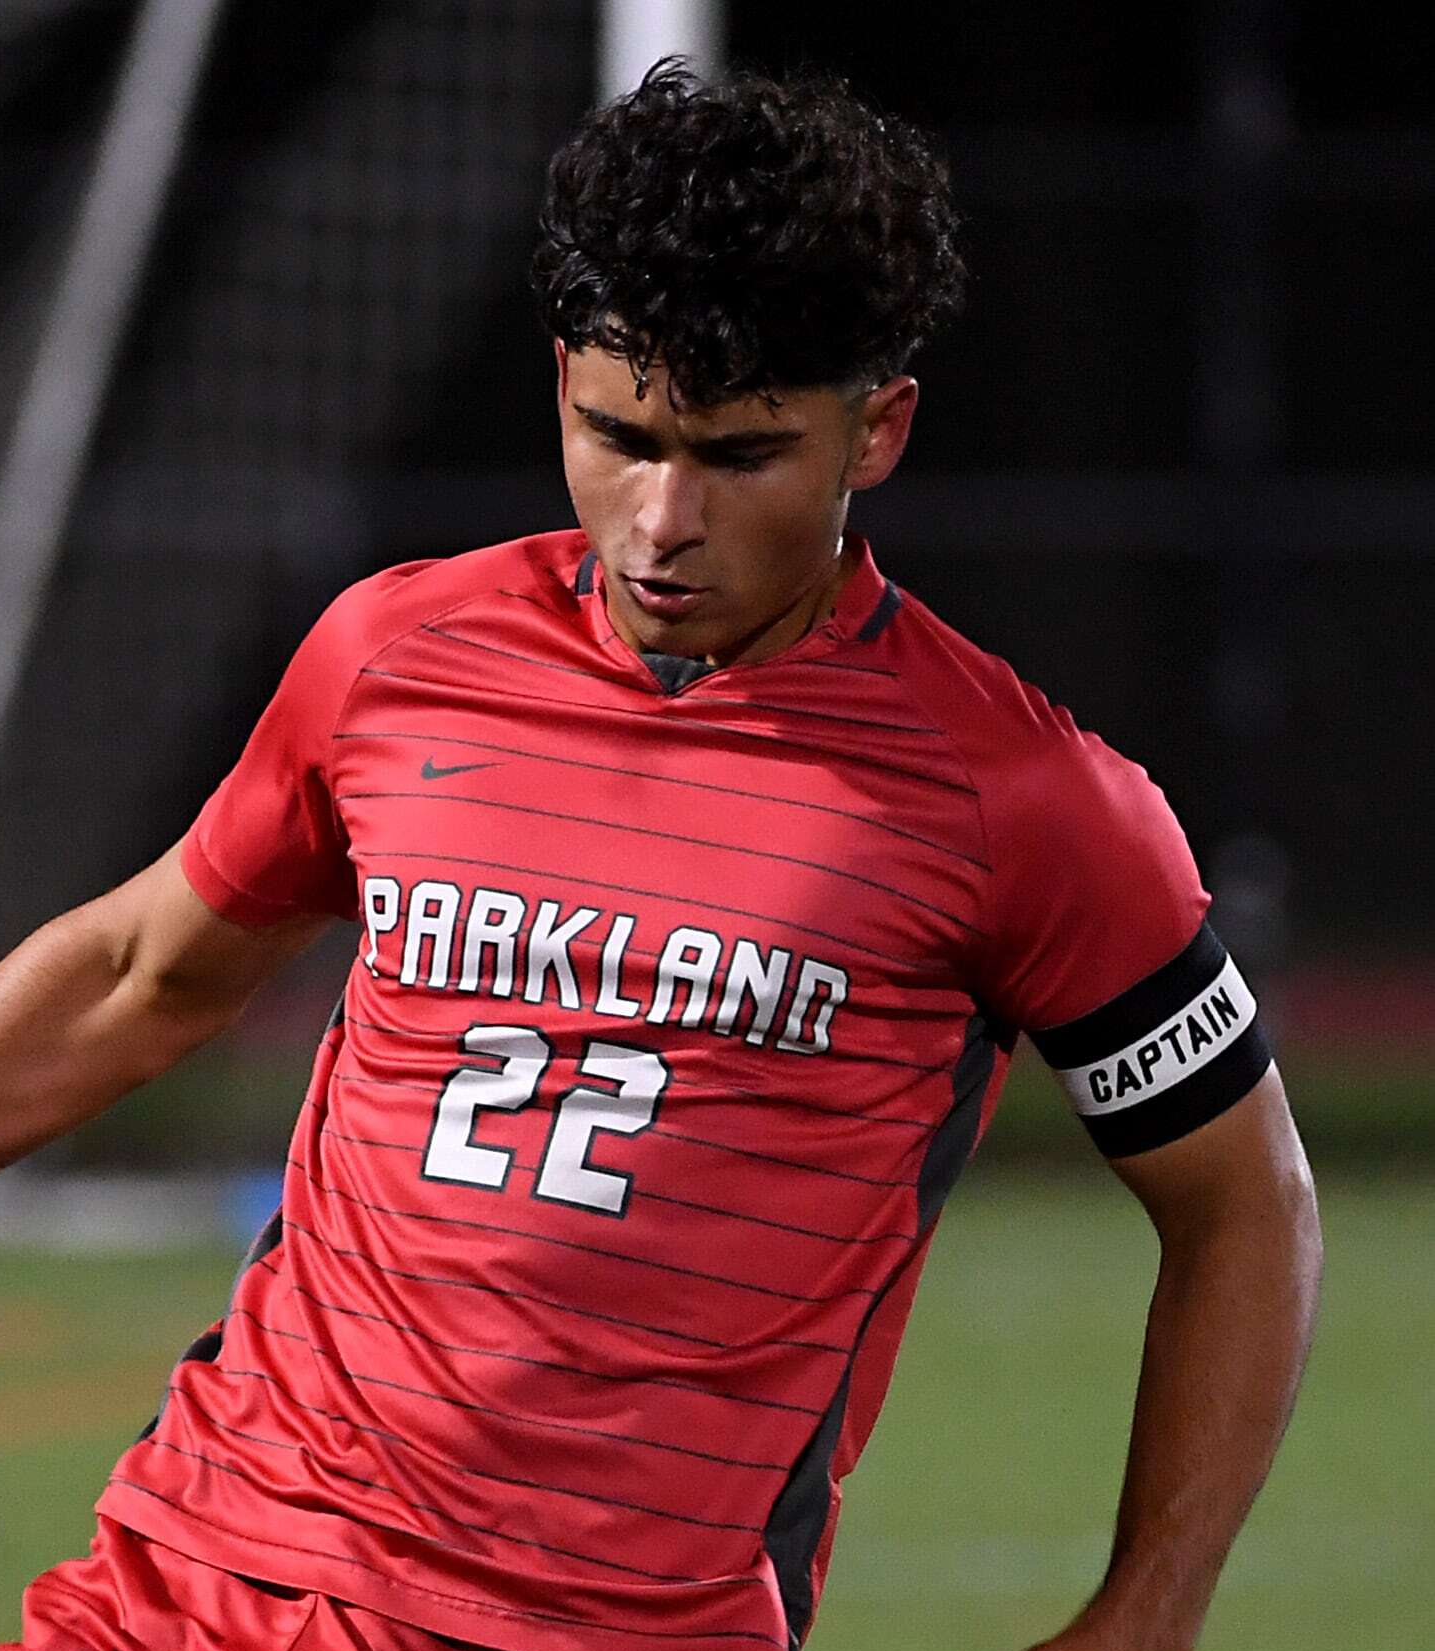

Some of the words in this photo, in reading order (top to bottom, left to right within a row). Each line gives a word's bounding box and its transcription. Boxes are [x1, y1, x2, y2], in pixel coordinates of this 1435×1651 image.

[363, 876, 850, 1055] PARKLAND
[1088, 985, 1240, 1104] CAPTAIN
[421, 1023, 673, 1220] 22
